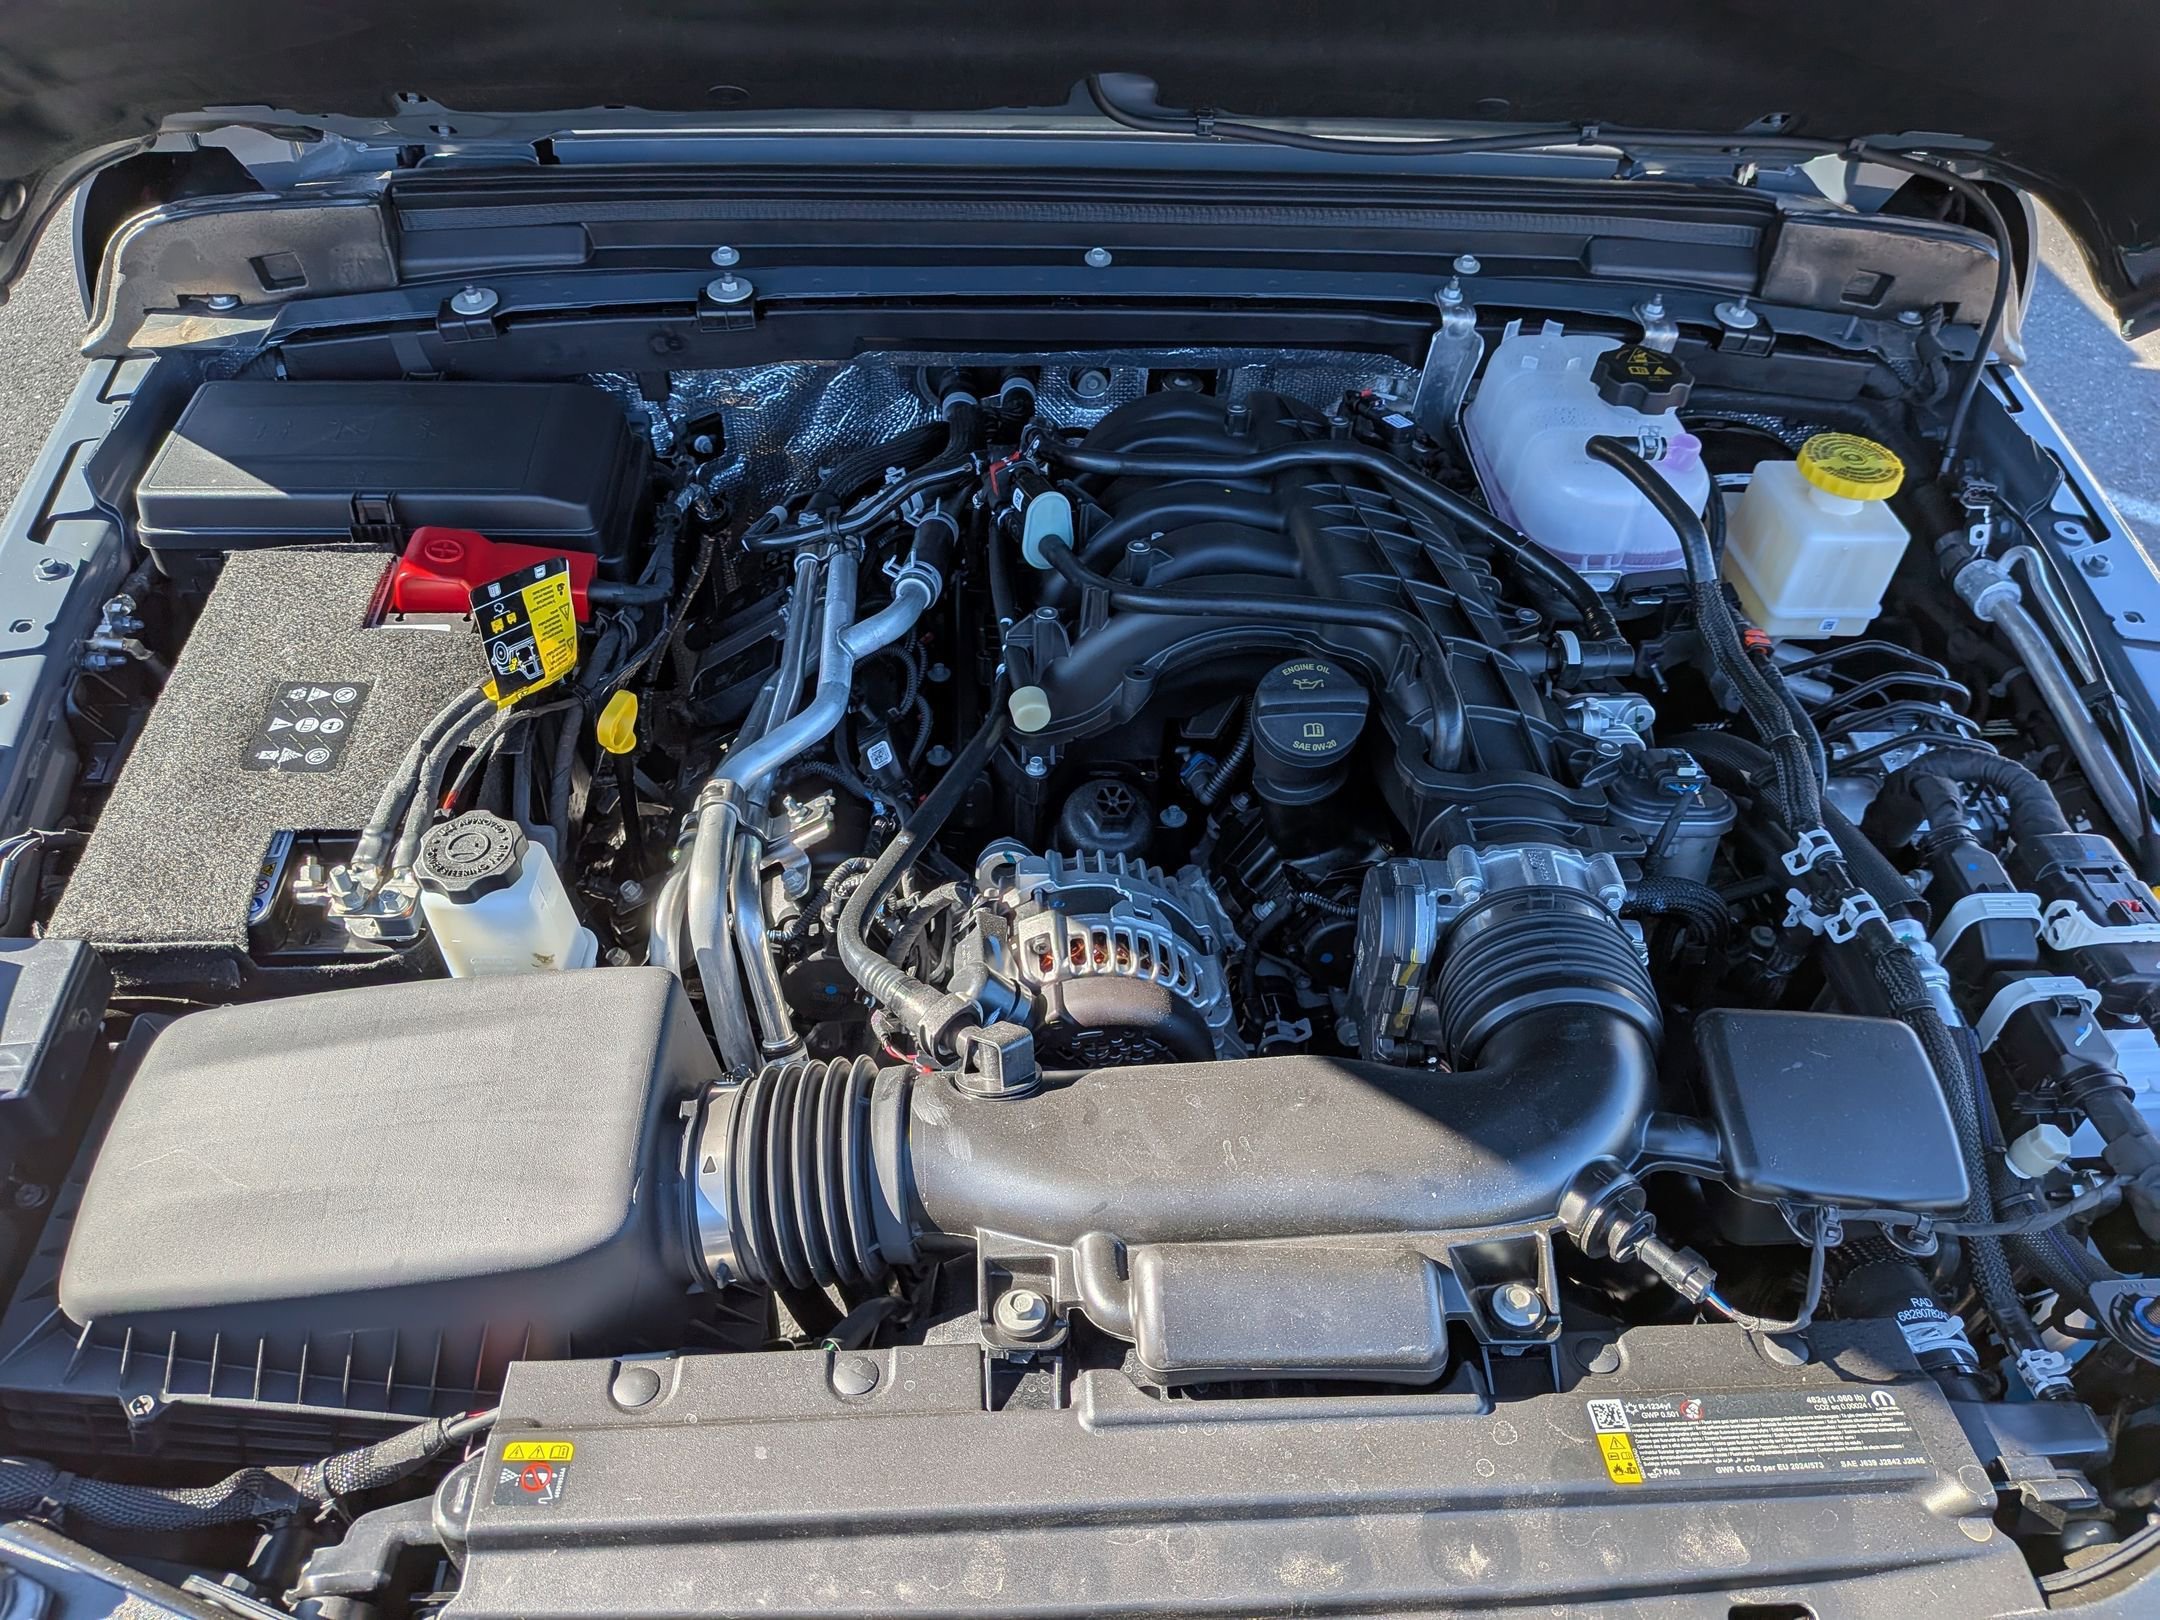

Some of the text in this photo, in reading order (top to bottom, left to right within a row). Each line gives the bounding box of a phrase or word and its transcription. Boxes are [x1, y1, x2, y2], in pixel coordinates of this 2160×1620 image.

[1282, 664, 1330, 676] ENGINE OIL
[1292, 739, 1337, 751] SAE 0W-20
[1910, 1297, 1933, 1307] RAD
[1806, 1395, 1827, 1404] 482g
[1855, 1394, 1867, 1402] lb)
[1641, 1410, 1680, 1419] GWP 0.501
[1715, 1466, 1735, 1474] GWP
[1744, 1464, 1761, 1472] CO2
[1763, 1465, 1776, 1473] per
[1776, 1462, 1789, 1470] EU
[1840, 1460, 1858, 1468] SAE
